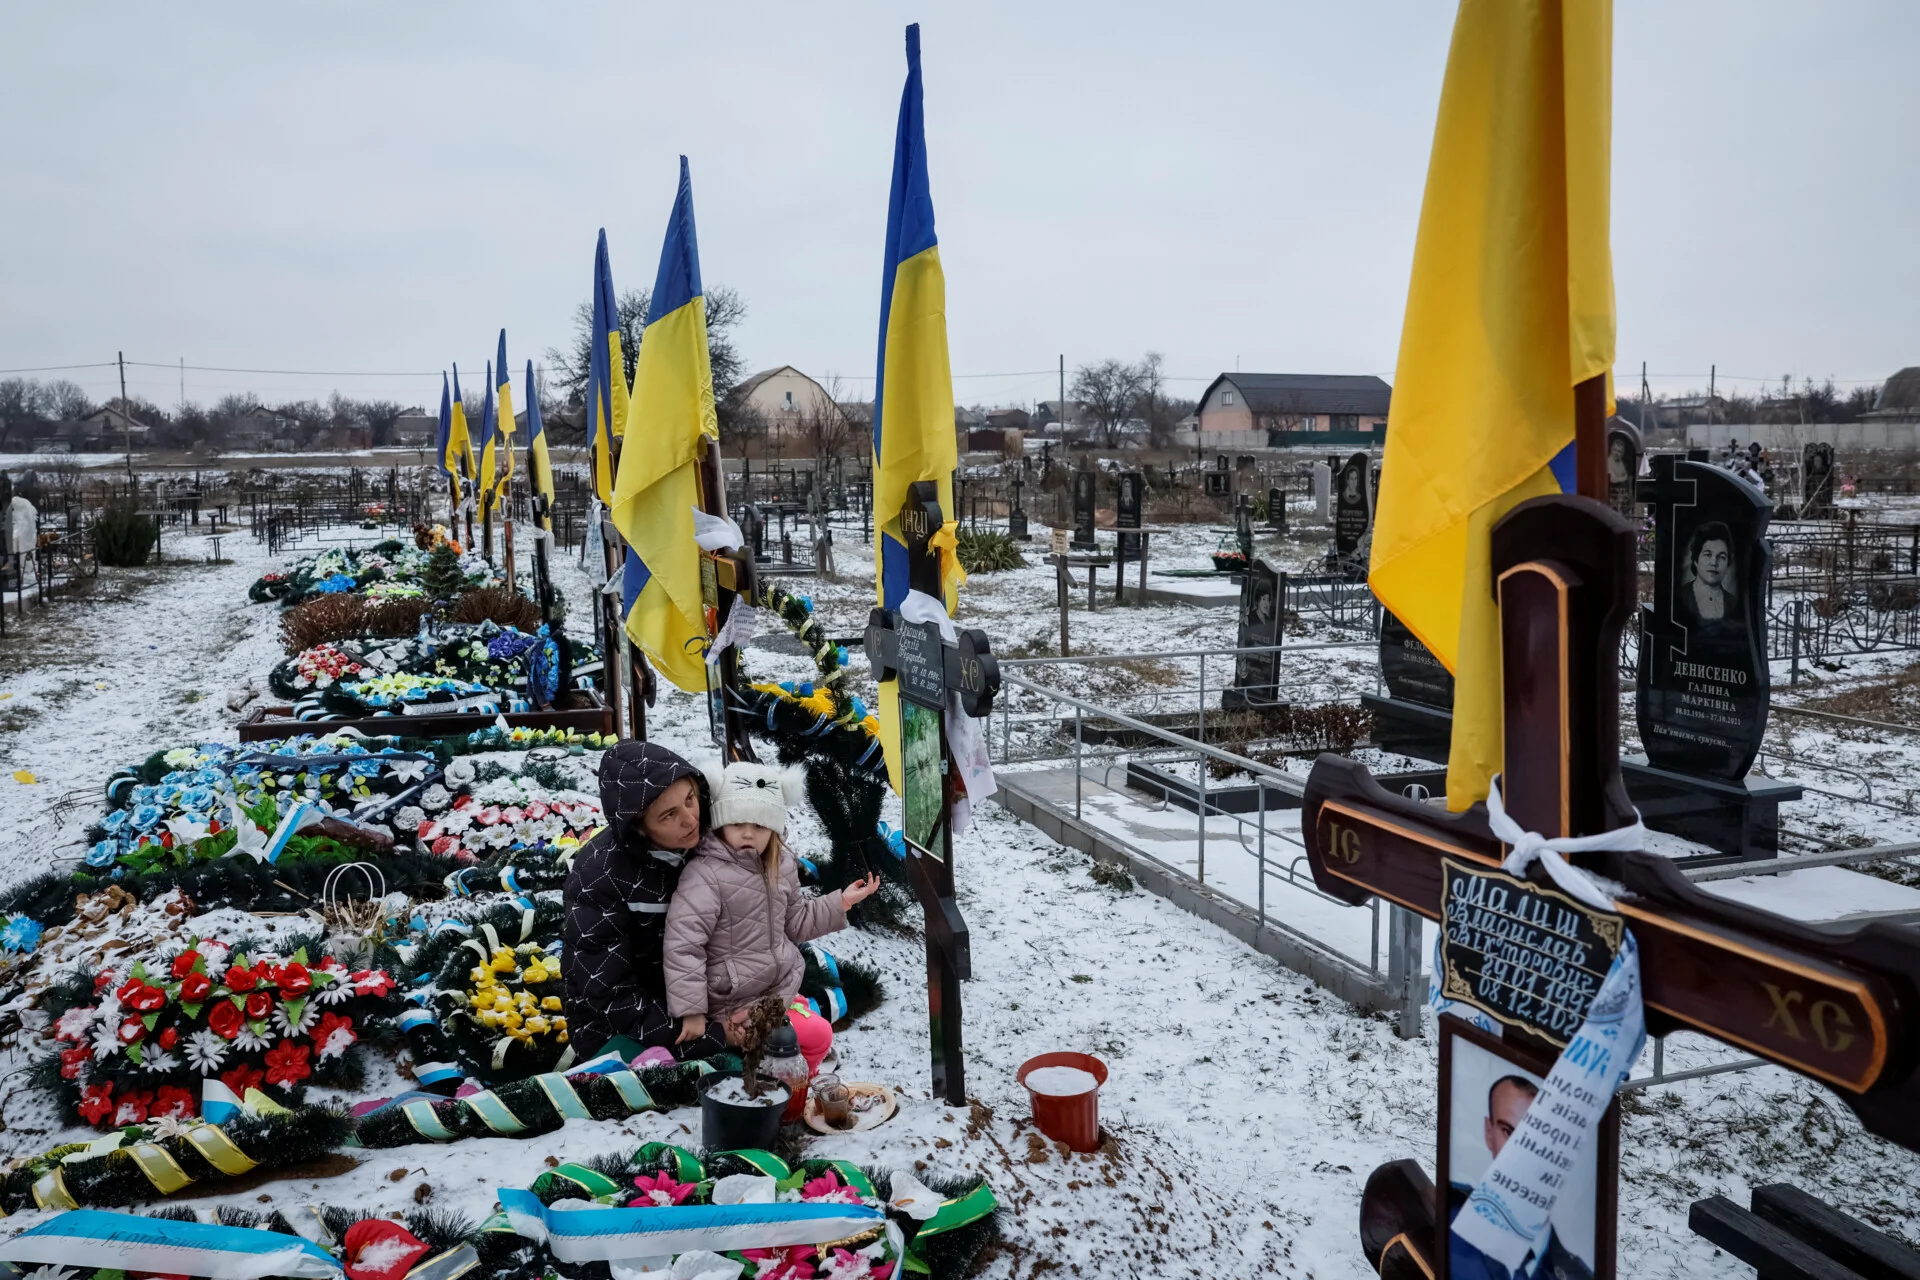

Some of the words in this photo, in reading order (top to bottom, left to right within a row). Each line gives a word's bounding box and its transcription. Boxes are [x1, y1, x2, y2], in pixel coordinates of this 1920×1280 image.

[1674, 661, 1747, 685] ДЕНИСЕНКО
[1688, 682, 1730, 697] ГАЛИНА
[1682, 694, 1737, 712] МАРКІВНА
[1452, 876, 1580, 940] Малиш
[1447, 900, 1587, 966] Владислав
[1478, 976, 1581, 1037] 08.12.202
